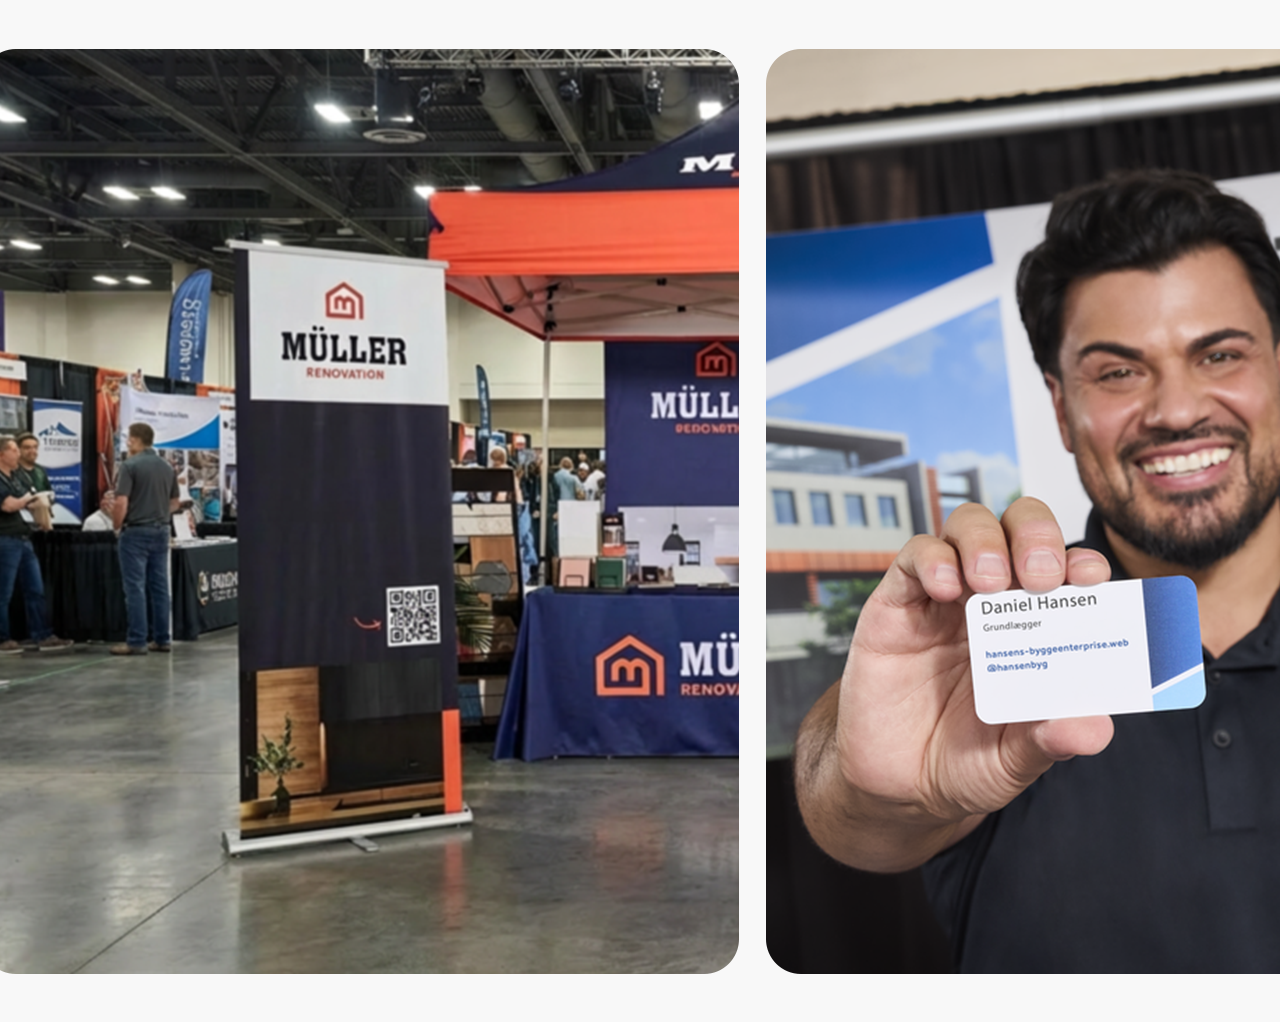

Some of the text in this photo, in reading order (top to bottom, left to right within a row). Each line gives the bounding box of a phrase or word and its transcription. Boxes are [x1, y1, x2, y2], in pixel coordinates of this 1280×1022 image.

[281, 325, 407, 366] MÜLLER
[306, 367, 385, 380] RENOVATION
[981, 594, 1098, 615] Daniel Hansen
[983, 619, 1042, 633] Grundlægger
[985, 638, 1129, 659] hansens-byggeenterprise.web
[987, 660, 1049, 673] @hansenbyg
[681, 683, 739, 696] RENOV
